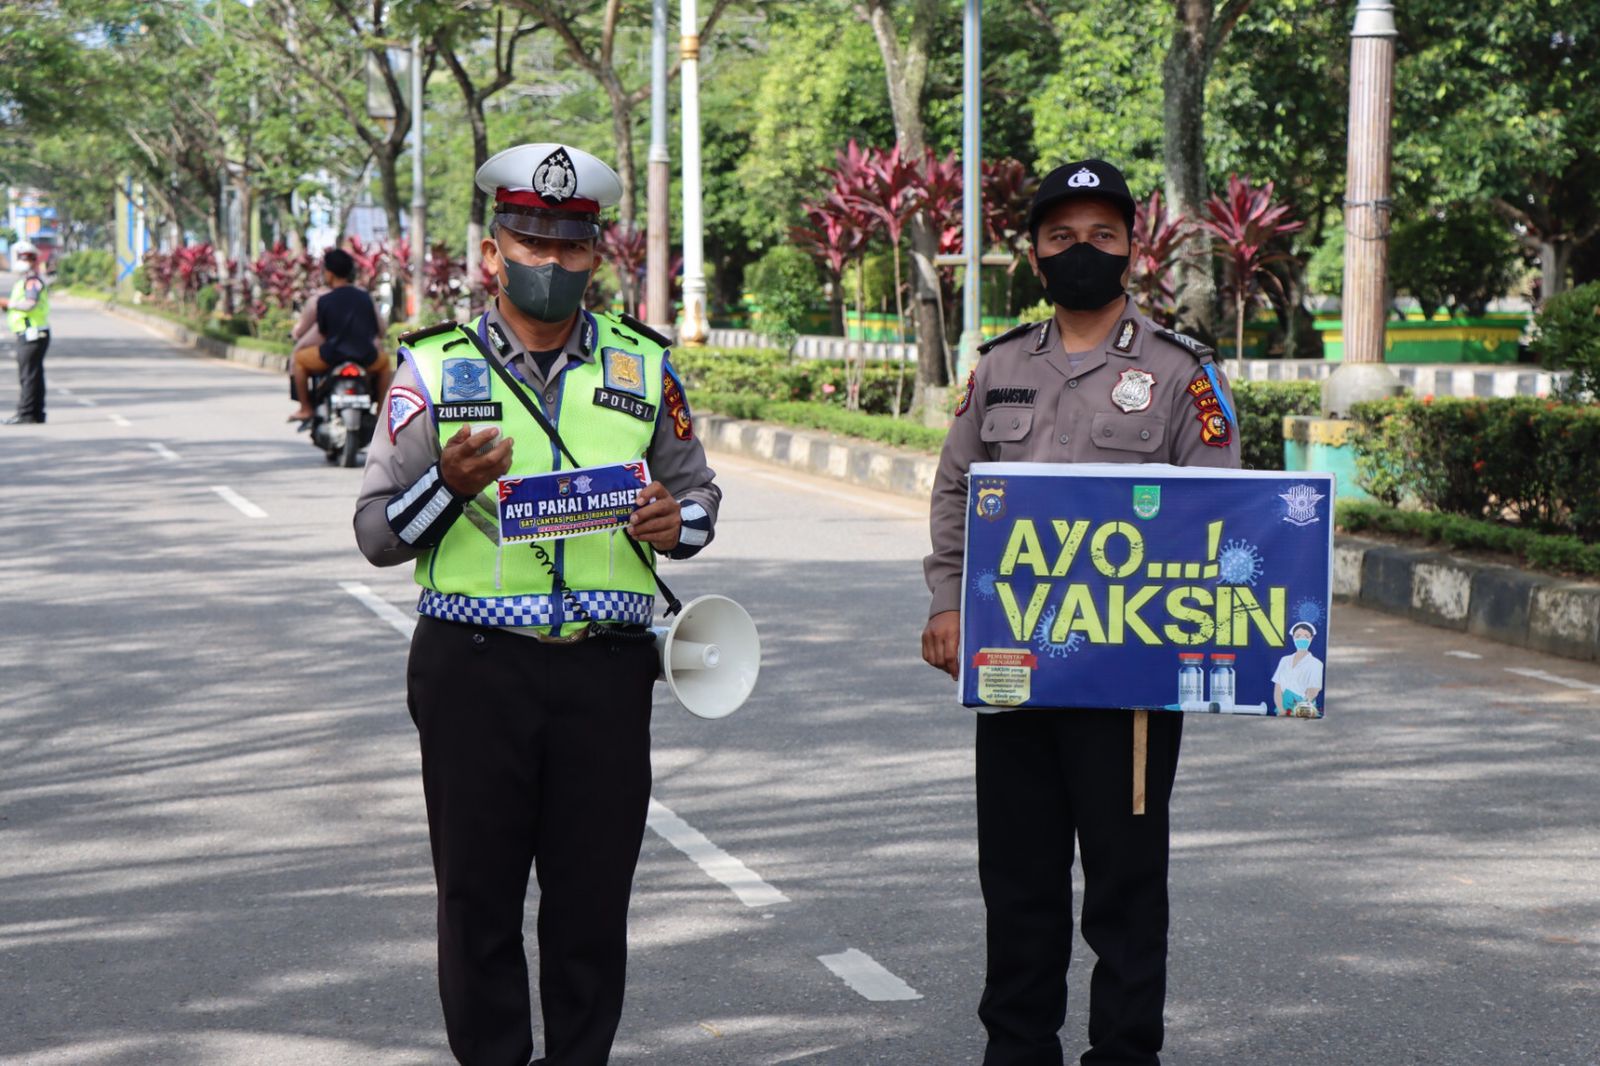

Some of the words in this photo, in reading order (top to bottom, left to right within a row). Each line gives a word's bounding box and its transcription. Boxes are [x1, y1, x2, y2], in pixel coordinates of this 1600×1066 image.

[438, 406, 495, 418] ZULPENDI
[600, 392, 649, 418] POLISI
[505, 502, 533, 519] AYO
[538, 496, 583, 516] PAKAI
[995, 582, 1286, 648] VAKSIN
